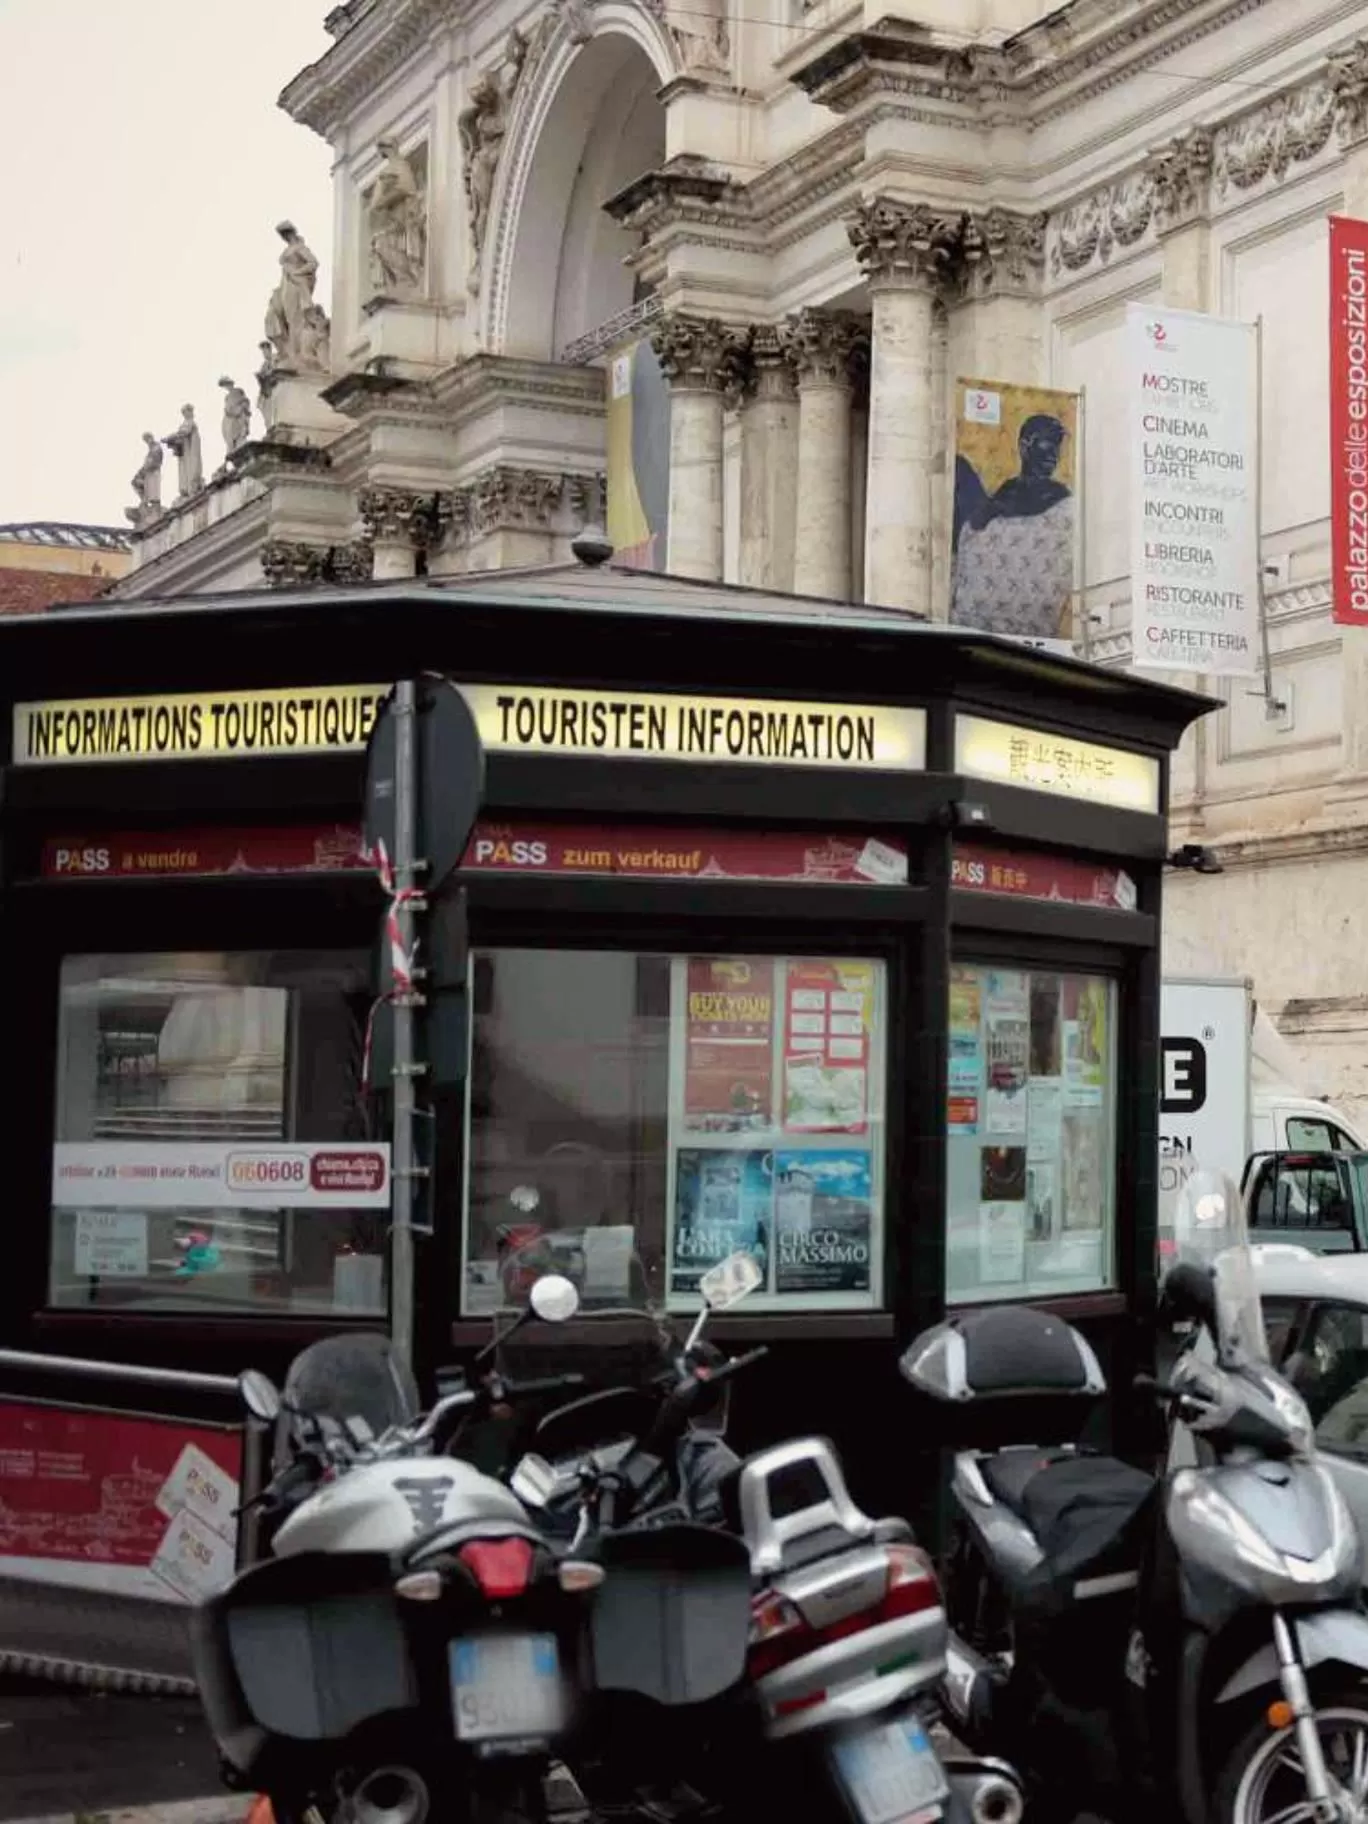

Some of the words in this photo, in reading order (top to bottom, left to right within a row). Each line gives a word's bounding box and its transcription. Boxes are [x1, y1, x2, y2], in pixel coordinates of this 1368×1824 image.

[1142, 373, 1209, 399] MOSTRE
[1142, 415, 1209, 438] CINEMA
[1143, 441, 1244, 470] LABORATORI
[1144, 500, 1224, 525] INCONTRI
[1144, 542, 1214, 565] LIBRERIA
[1146, 583, 1245, 611] RISTORANTE
[1146, 626, 1249, 651] CAFFETTERIA
[27, 705, 201, 757] INFORMATIONS
[211, 694, 388, 748] TOURISTIQUE
[496, 695, 667, 751] TOURISTEN
[677, 706, 875, 761] INFORMATION
[56, 847, 110, 872] PASS
[475, 839, 548, 866] PASS
[562, 848, 611, 867] zum
[616, 848, 703, 870] verkauf
[951, 859, 985, 885] PASS
[778, 1229, 840, 1247] CIRCO
[778, 1244, 868, 1264] MASSIMO
